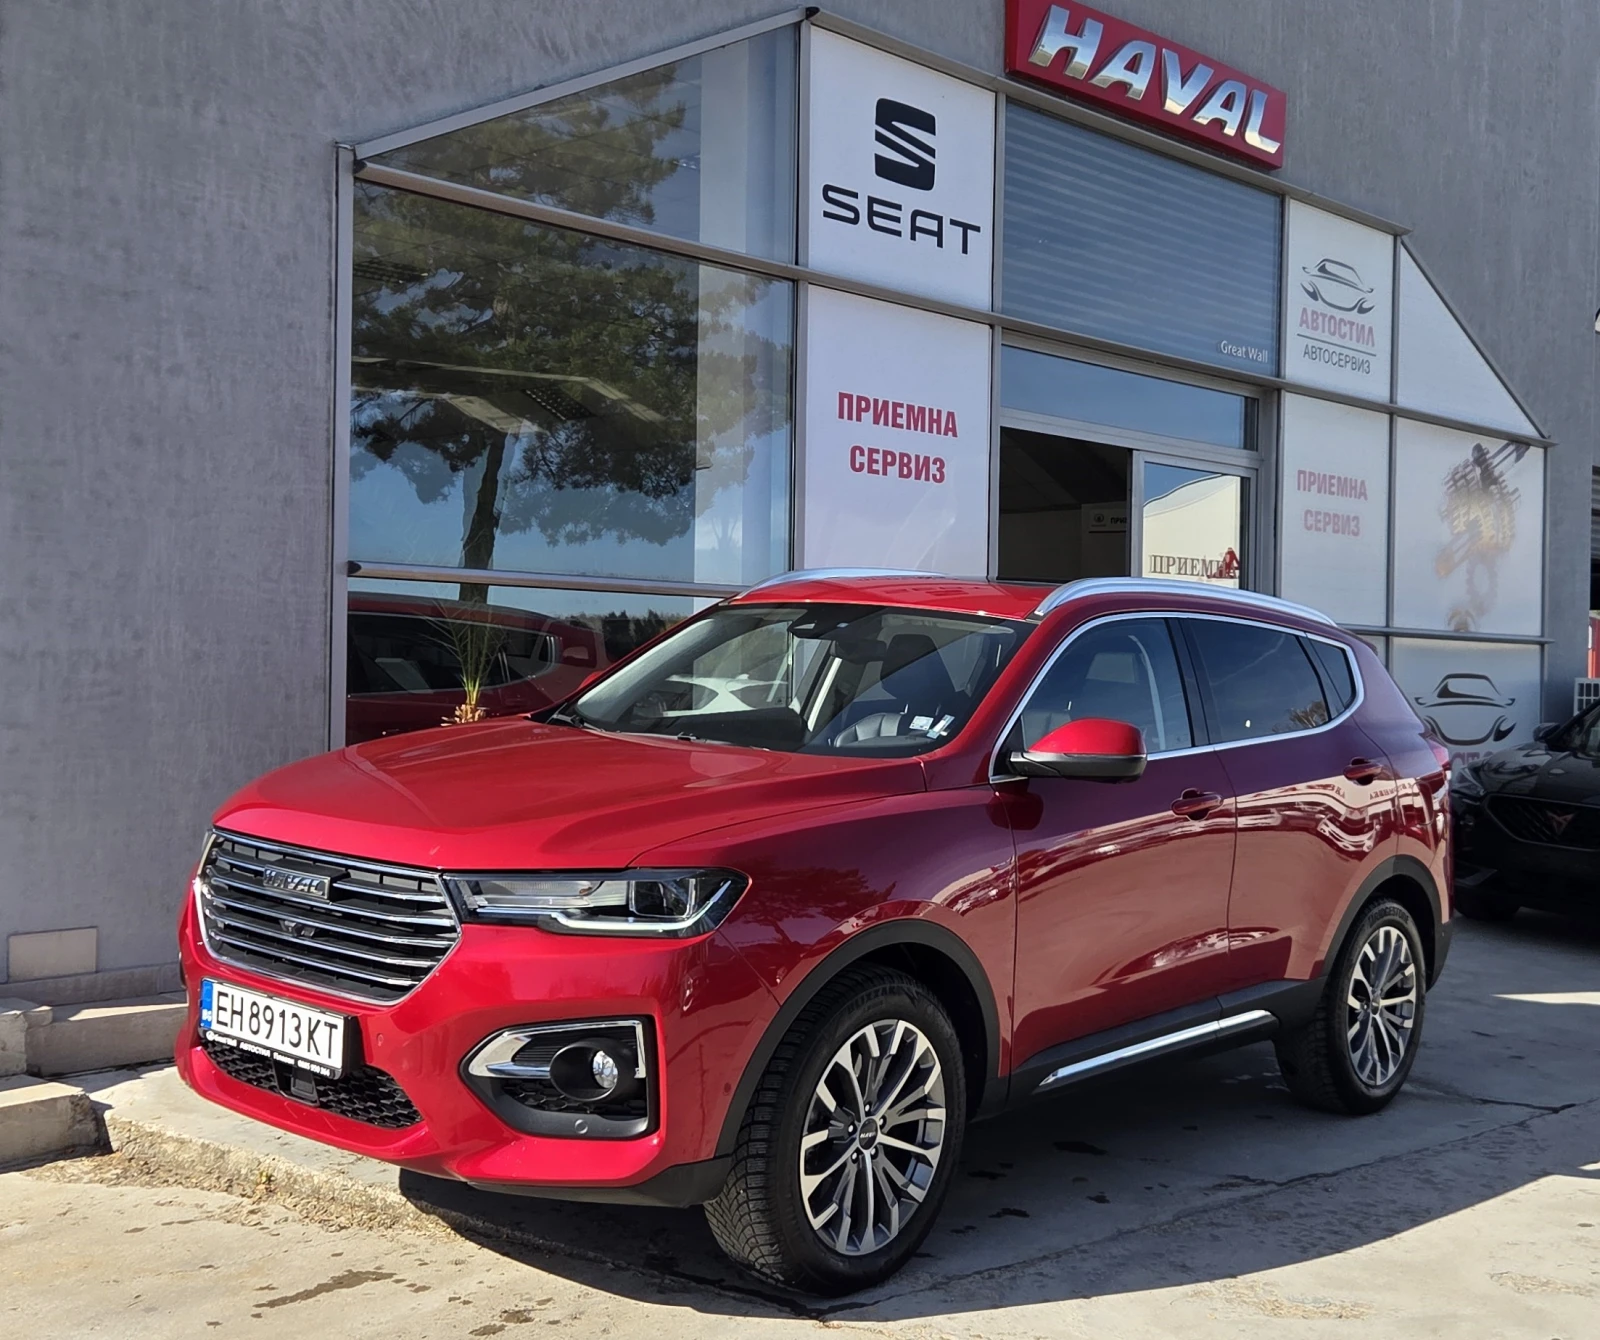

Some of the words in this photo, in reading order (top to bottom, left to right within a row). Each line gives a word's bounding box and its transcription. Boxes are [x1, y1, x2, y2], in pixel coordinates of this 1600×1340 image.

[1028, 3, 1281, 154] HAVAL
[821, 183, 981, 256] SEAT
[1299, 306, 1375, 348] АВТОСТИЛ
[1220, 340, 1246, 359] Great
[1248, 347, 1268, 363] Wall
[1302, 343, 1371, 375] АВТОСЕРВИЗ
[837, 391, 958, 438] ПРИЕМНА
[849, 445, 946, 484] СЕРВИЗ
[1296, 469, 1368, 502] ПРИЕМНА
[1303, 508, 1360, 537] СЕРВИЗ
